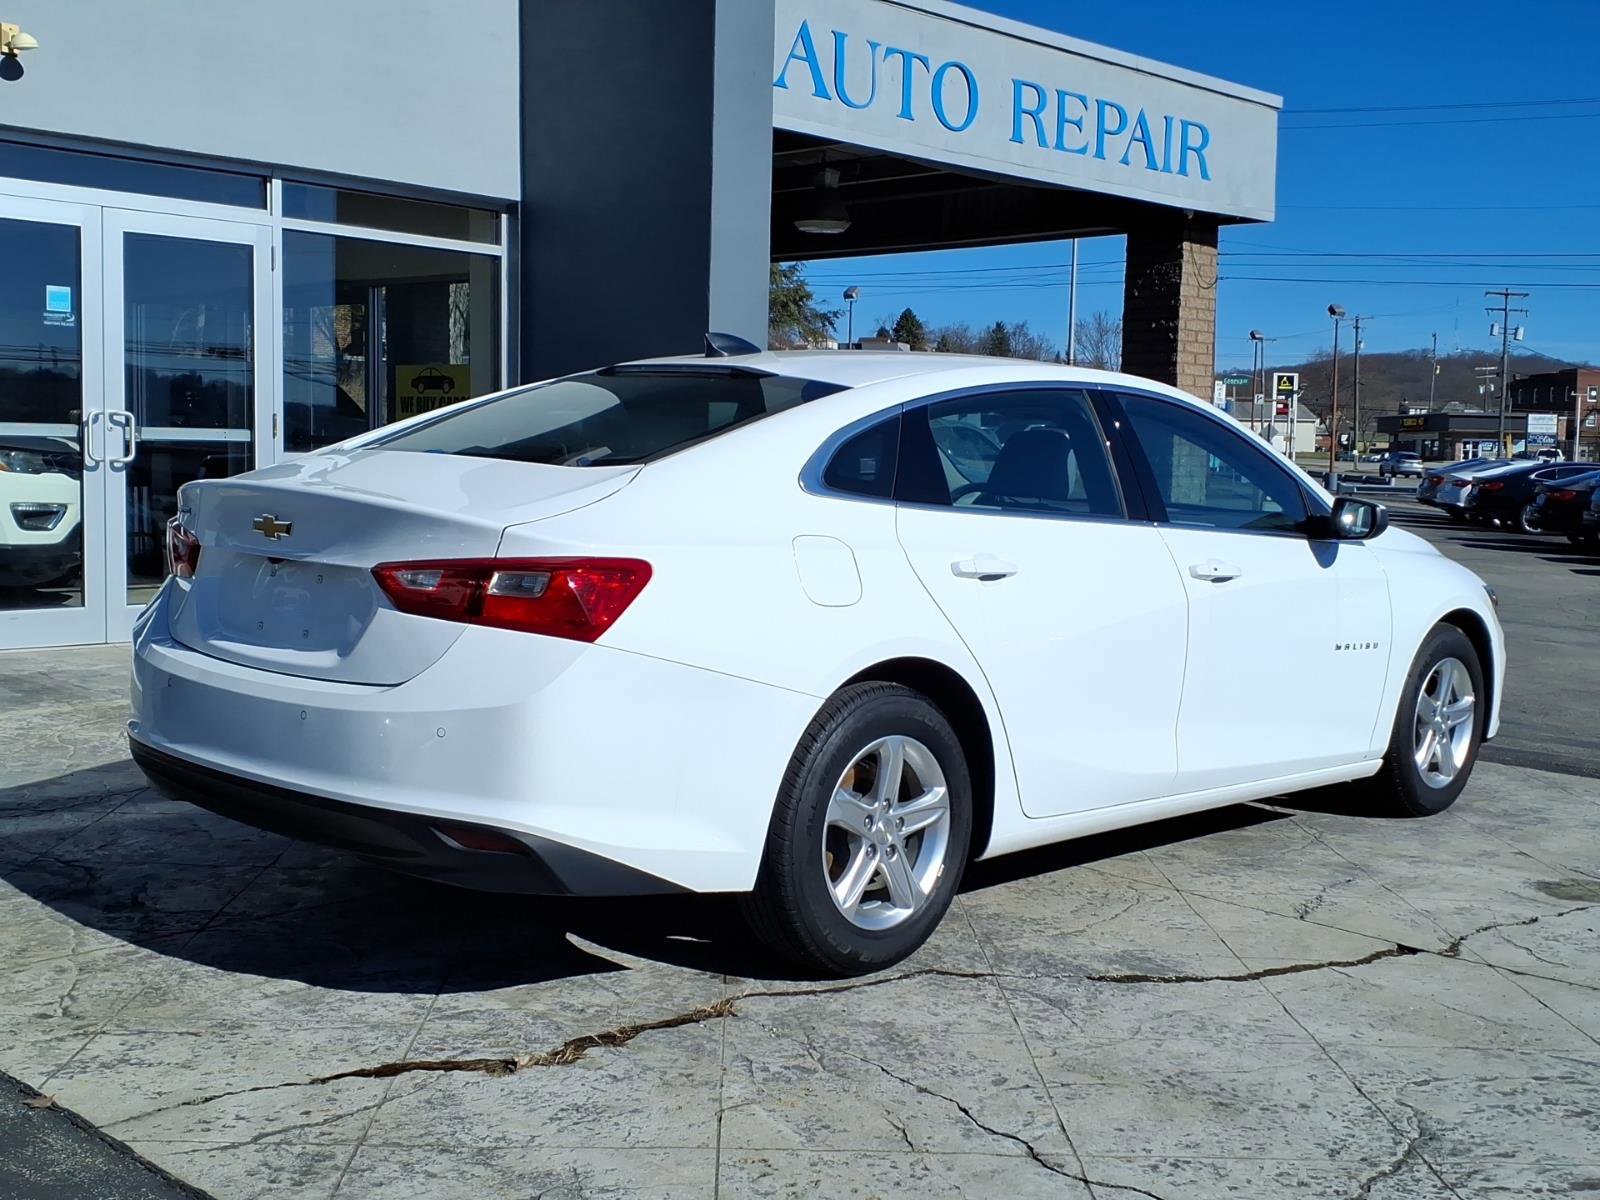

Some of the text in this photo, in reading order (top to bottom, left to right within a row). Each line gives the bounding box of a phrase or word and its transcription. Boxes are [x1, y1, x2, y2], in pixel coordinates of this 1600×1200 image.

[773, 18, 1212, 181] AUTO REPAIR
[400, 396, 414, 413] WE
[416, 396, 437, 413] BUY
[1335, 642, 1379, 651] MALIBU
